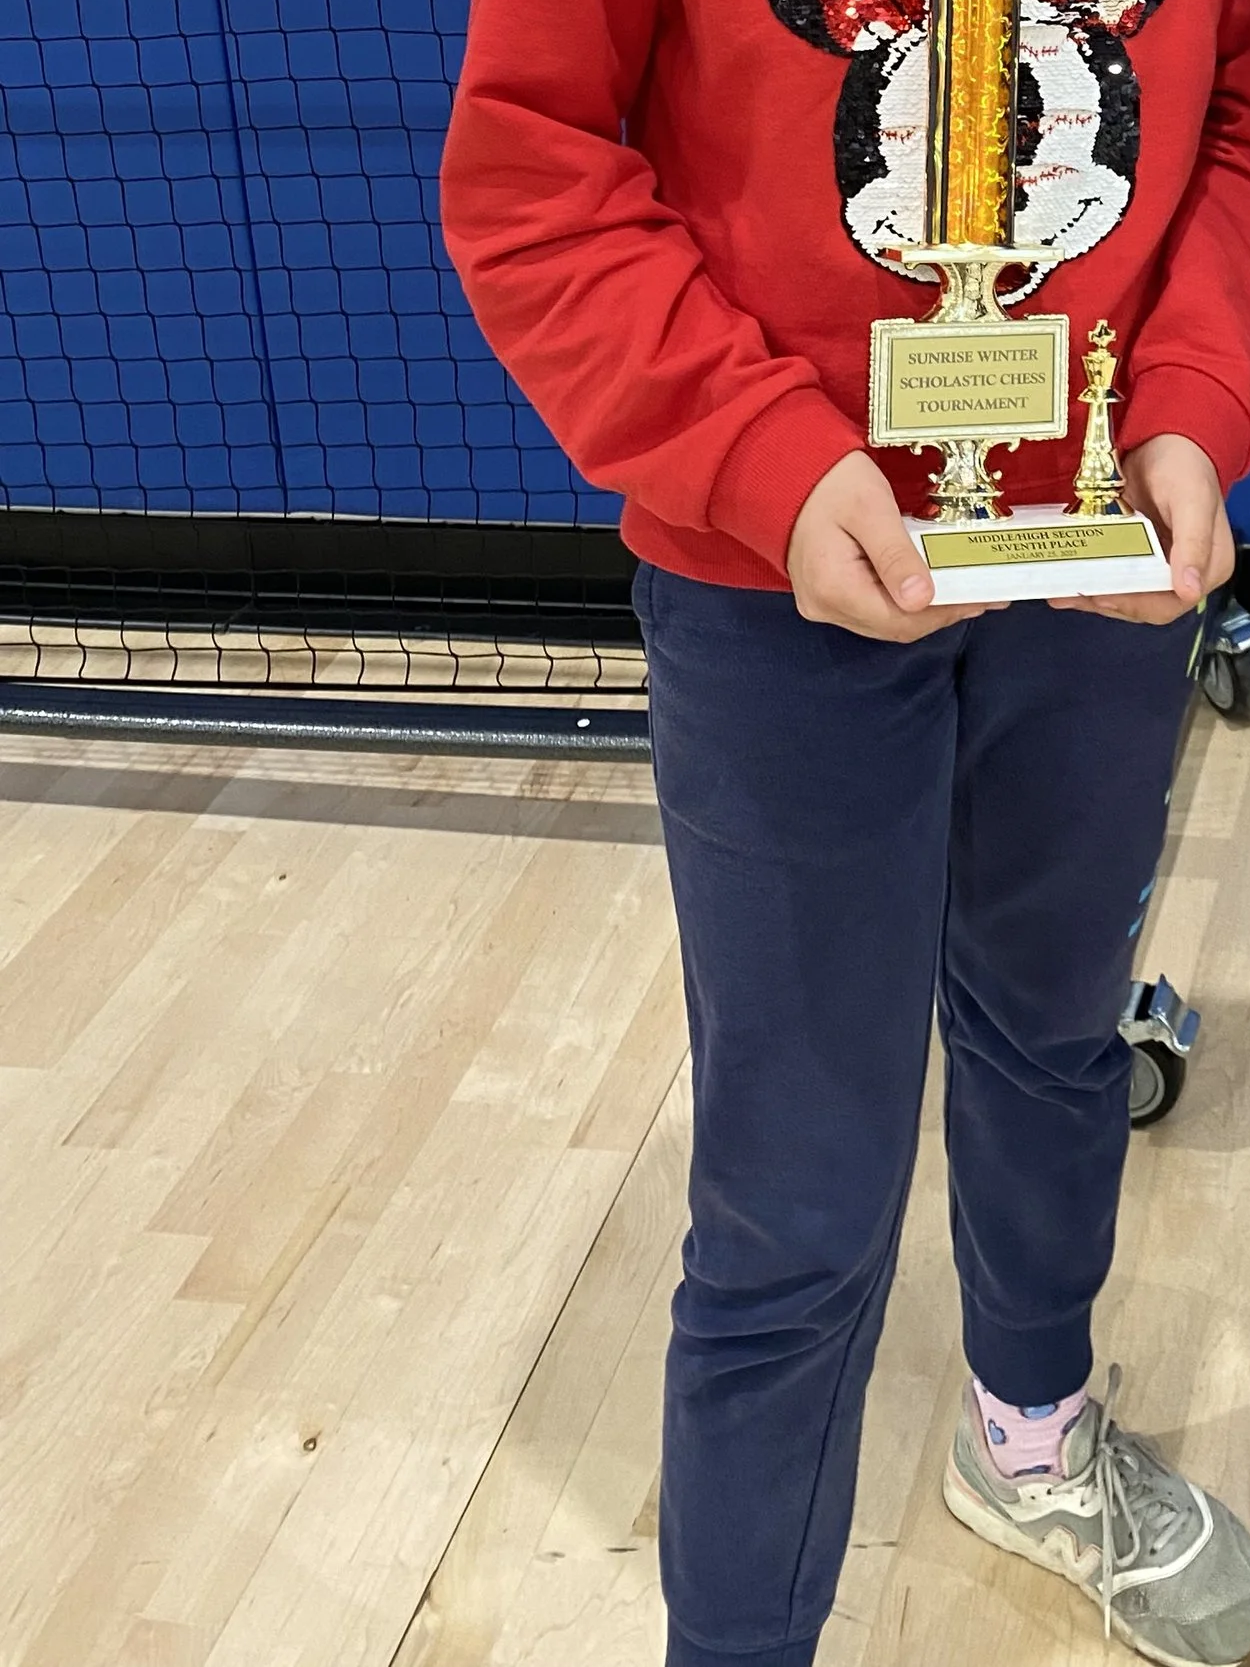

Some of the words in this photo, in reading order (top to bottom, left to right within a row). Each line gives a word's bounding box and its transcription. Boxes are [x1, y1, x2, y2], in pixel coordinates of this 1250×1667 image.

[908, 350, 974, 365] SUNRISE
[978, 348, 1039, 363] WINTER
[900, 374, 998, 390] SCHOLASTIC
[1000, 372, 1046, 385] CHESS
[917, 396, 1029, 413] TOURNAMENT
[968, 531, 1050, 544] MIDDLE/HIGH
[1052, 528, 1104, 539] SECTION
[991, 541, 1048, 553] SEVENTH
[1050, 539, 1088, 548] PLACE
